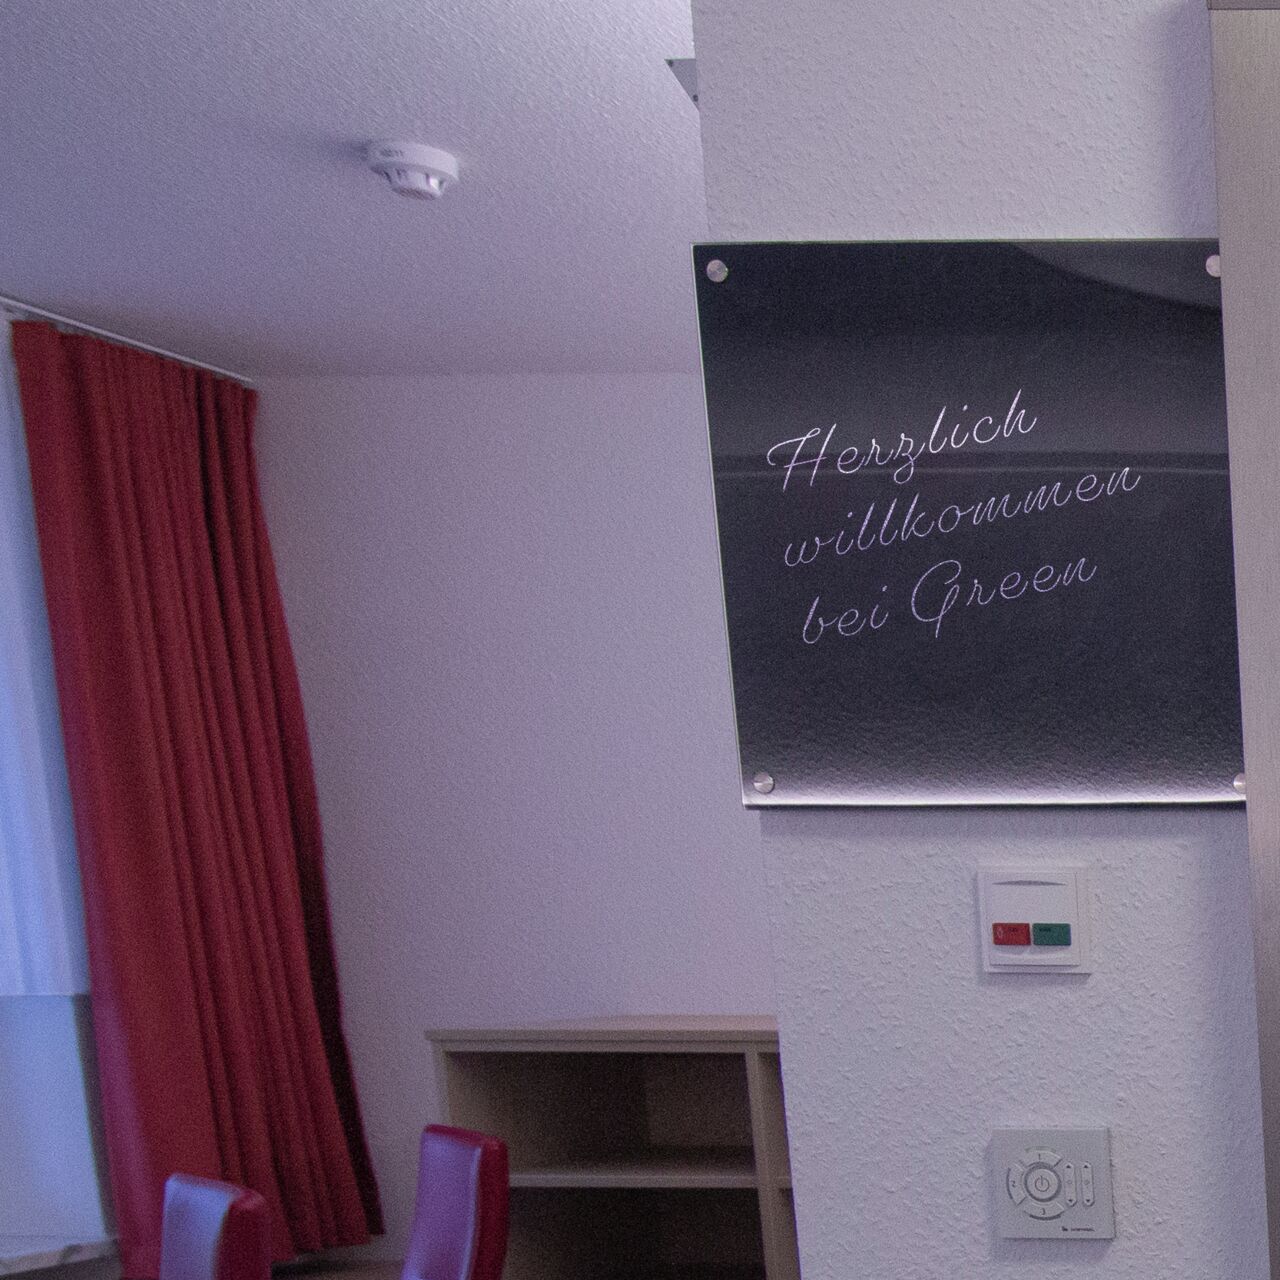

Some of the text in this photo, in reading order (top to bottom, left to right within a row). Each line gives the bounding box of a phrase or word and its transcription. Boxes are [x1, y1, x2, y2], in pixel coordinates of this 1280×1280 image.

[766, 389, 1038, 492] Herzlich
[784, 467, 1141, 567] willkommen
[802, 556, 1098, 644] bei Green
